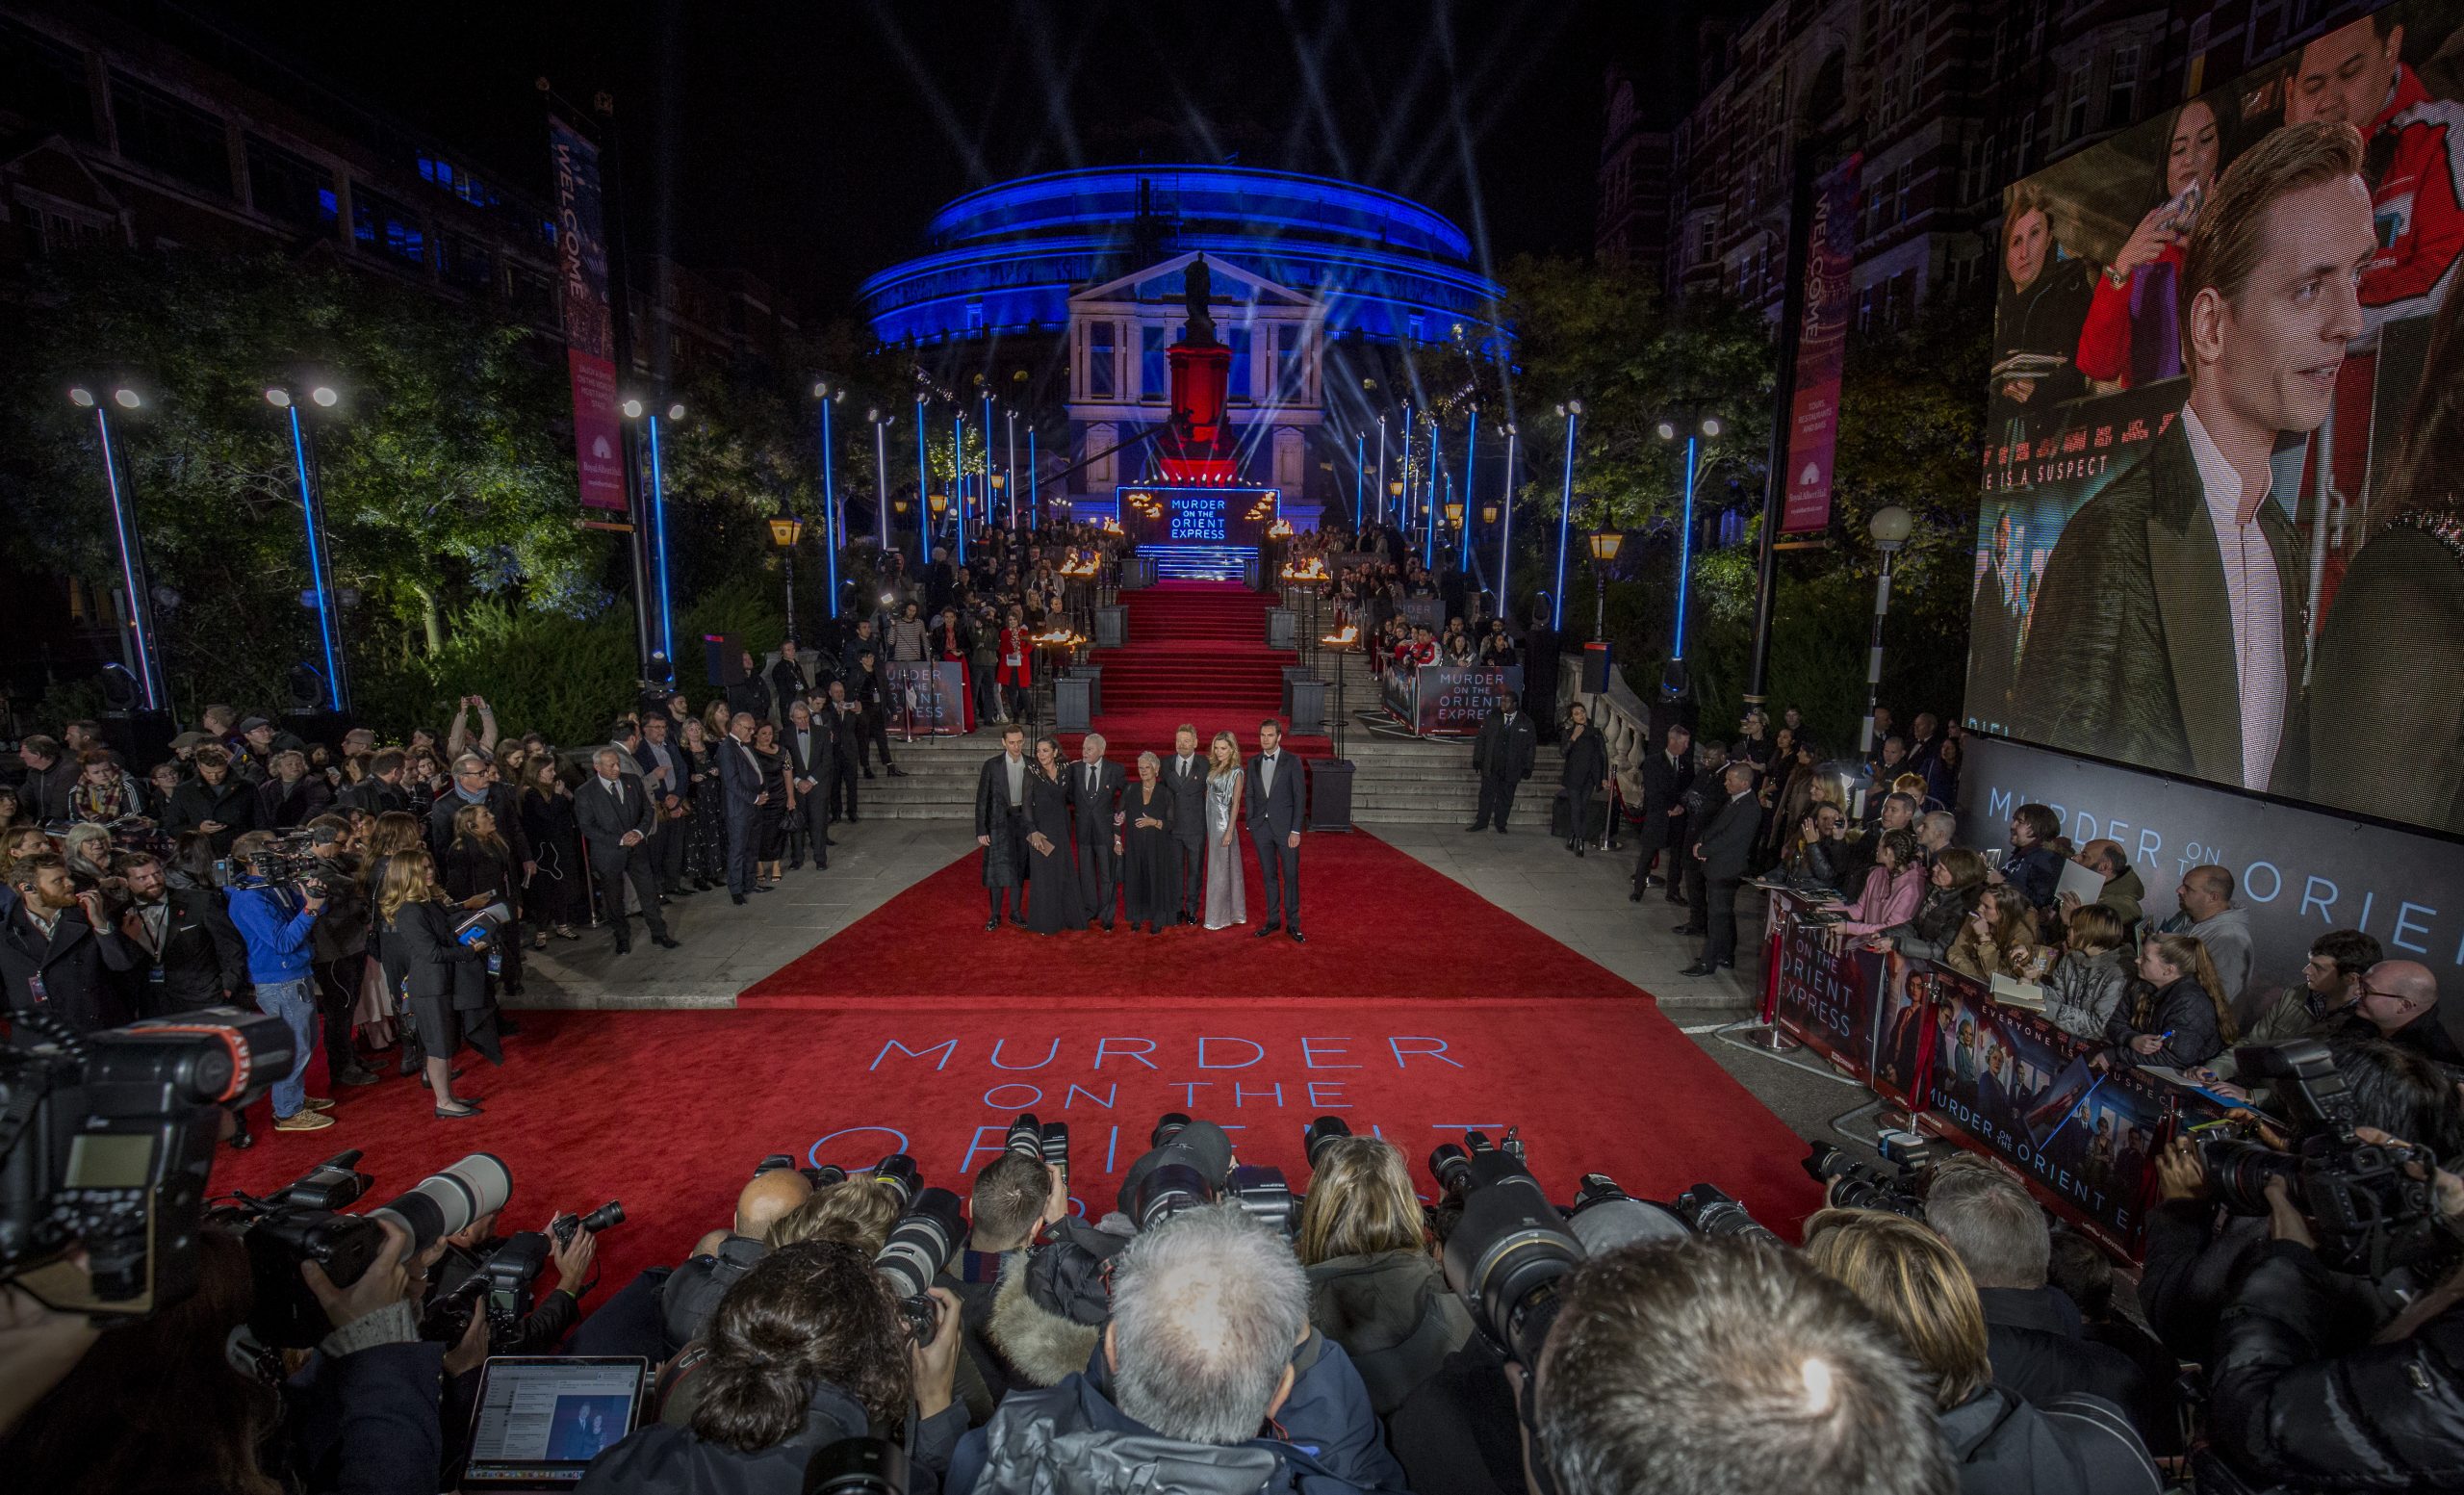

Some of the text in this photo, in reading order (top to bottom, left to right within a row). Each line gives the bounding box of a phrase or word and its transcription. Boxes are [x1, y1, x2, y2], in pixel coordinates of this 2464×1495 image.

[557, 142, 583, 300] WELCOME
[1806, 192, 1831, 341] WELCOME
[2001, 470, 2013, 487] IS
[2020, 467, 2029, 485] A
[2038, 454, 2108, 484] SUSPECT
[1171, 500, 1225, 509] MURDER
[1171, 518, 1225, 528] ORIENT
[1171, 528, 1225, 539] EXPRESS
[886, 669, 941, 681] UDER
[1440, 674, 1503, 685] MURDER
[1472, 686, 1491, 695] THE
[1439, 696, 1502, 708] ORIENT
[2186, 841, 2220, 866] ON
[2244, 861, 2464, 966] ORIE
[1796, 939, 1812, 959] ON
[1816, 949, 1838, 974] THE
[1786, 980, 1850, 1037] XPRESS
[1982, 1005, 2051, 1046] EVERYONE
[2061, 1044, 2074, 1058] IS
[869, 1036, 1465, 1071] MURDER
[984, 1081, 1353, 1110] ON THE
[2104, 1070, 2168, 1107] SUSPEC
[1998, 1129, 2012, 1144] ON
[1996, 1136, 2106, 1212] THE ORIENT
